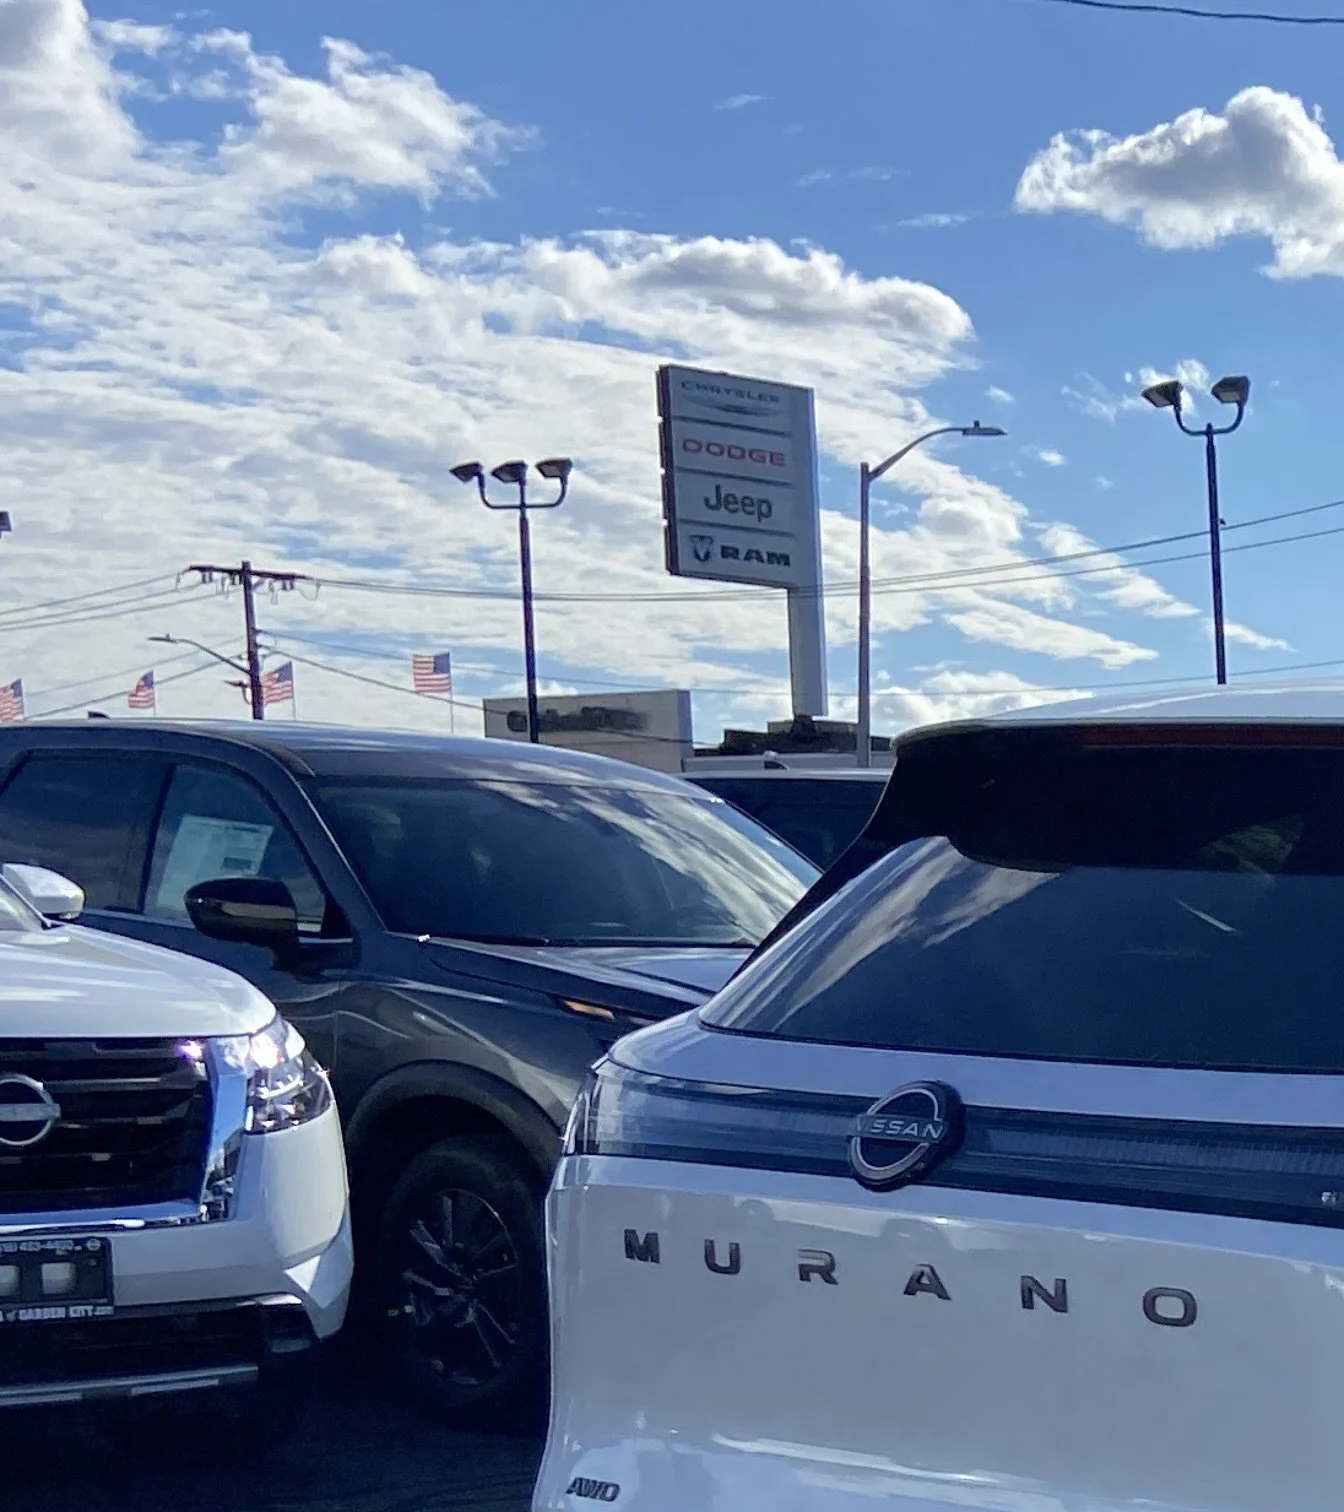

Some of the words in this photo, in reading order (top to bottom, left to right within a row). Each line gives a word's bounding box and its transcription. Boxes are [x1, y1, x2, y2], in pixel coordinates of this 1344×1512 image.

[681, 380, 780, 403] CHRYSLER
[682, 438, 786, 466] DODGE
[703, 484, 773, 522] Jeep
[720, 545, 791, 567] RAM
[856, 1114, 943, 1140] NISSAN
[624, 1229, 1197, 1328] MURANO
[566, 1475, 620, 1502] AWD
